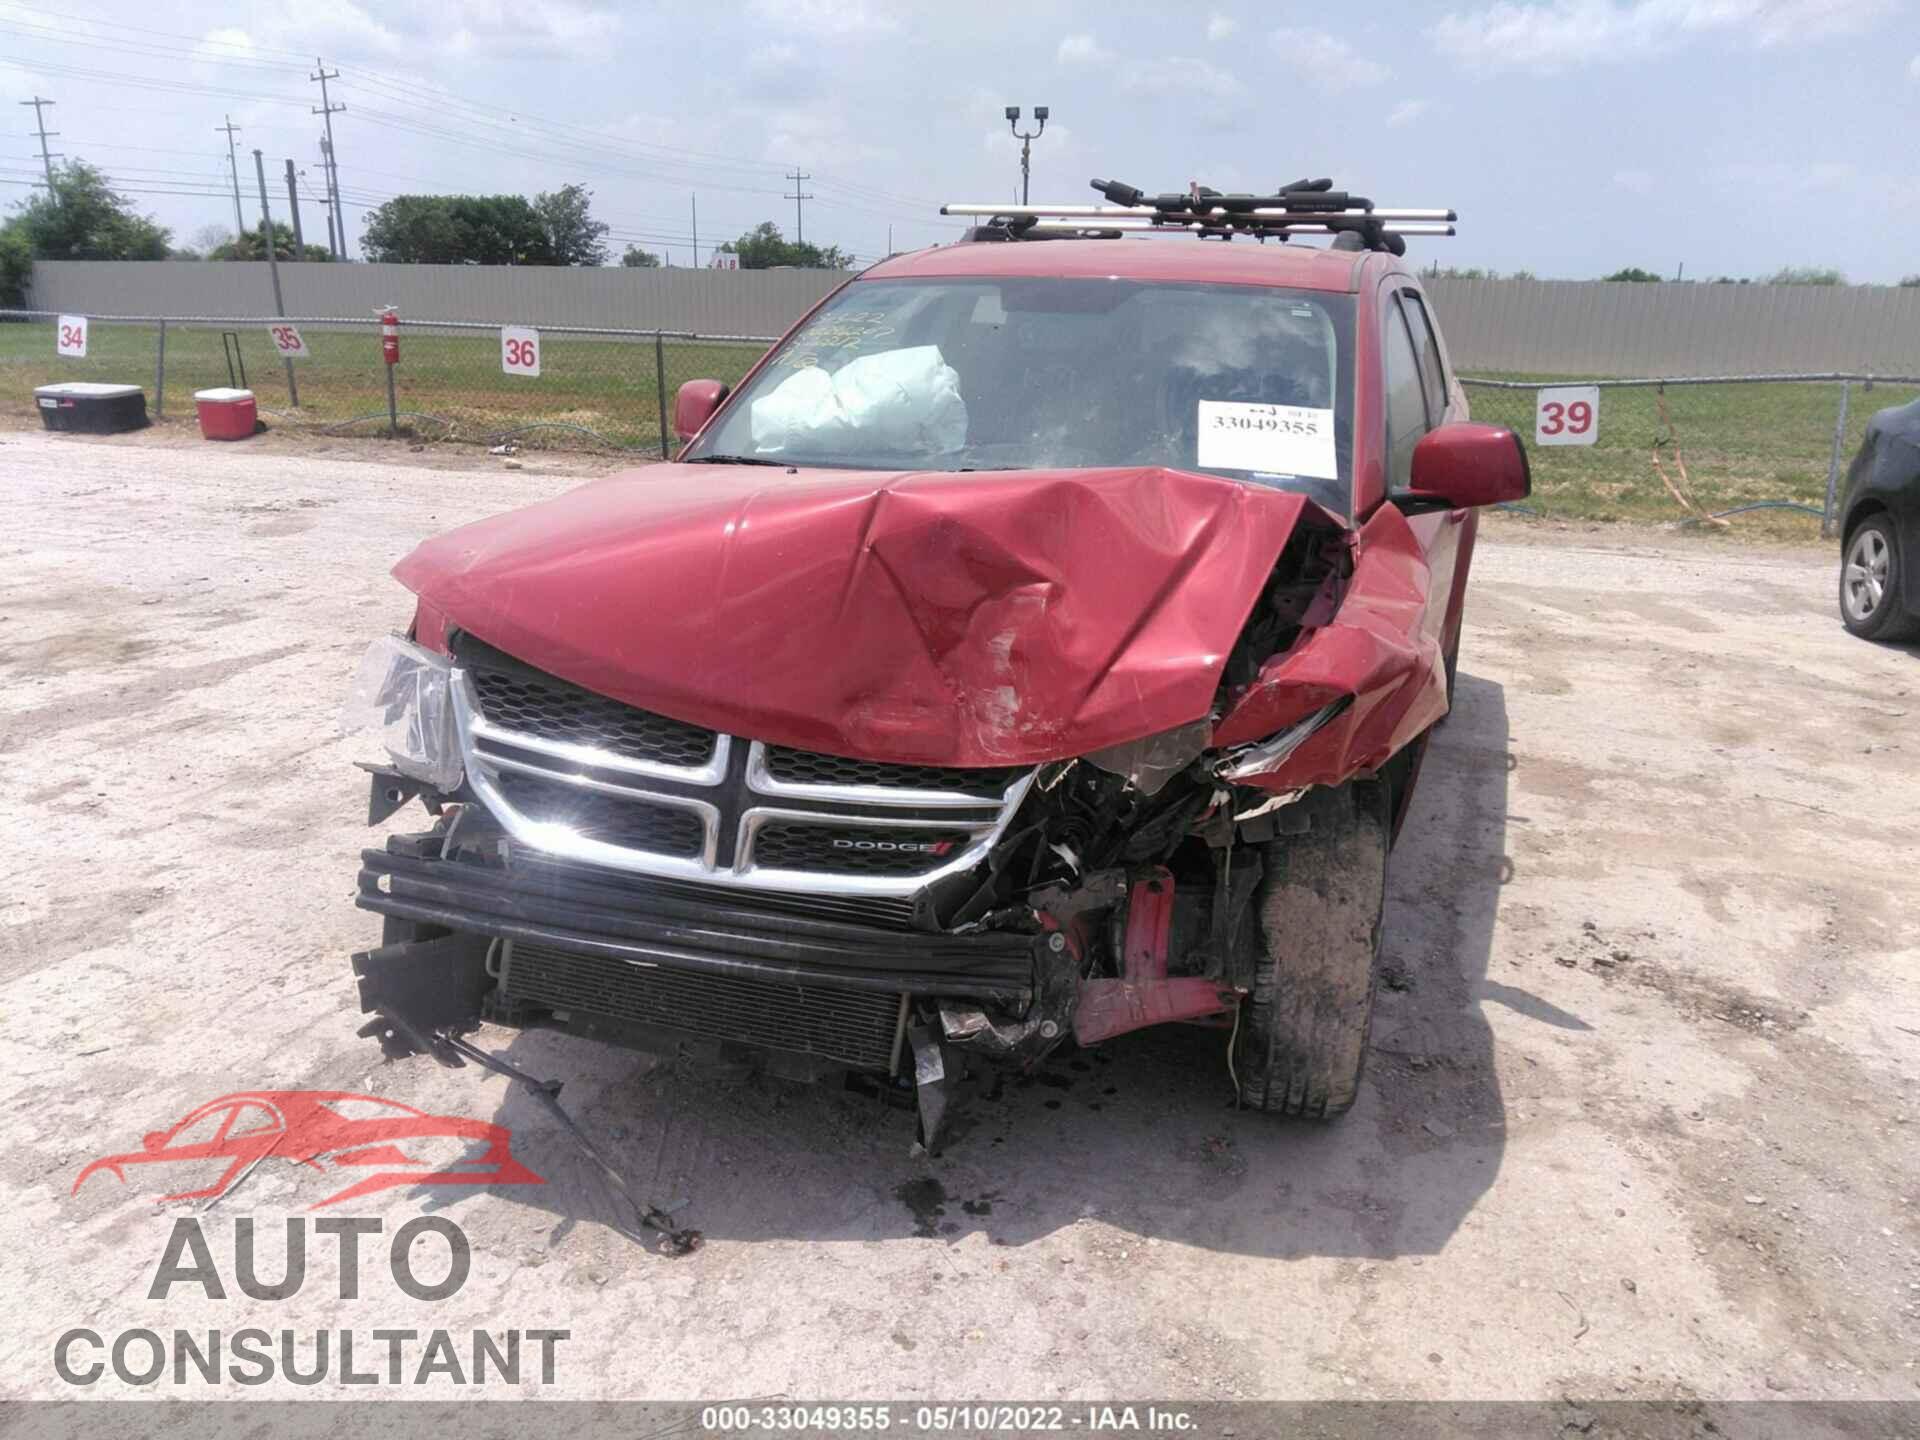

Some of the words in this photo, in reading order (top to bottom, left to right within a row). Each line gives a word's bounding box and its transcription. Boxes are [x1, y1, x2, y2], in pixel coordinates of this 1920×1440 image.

[60, 325, 83, 349] 34
[272, 326, 302, 350] 35
[505, 338, 536, 367] 36
[1212, 415, 1319, 436] 33049355
[1540, 401, 1592, 435] 39
[832, 839, 938, 853] DODGE
